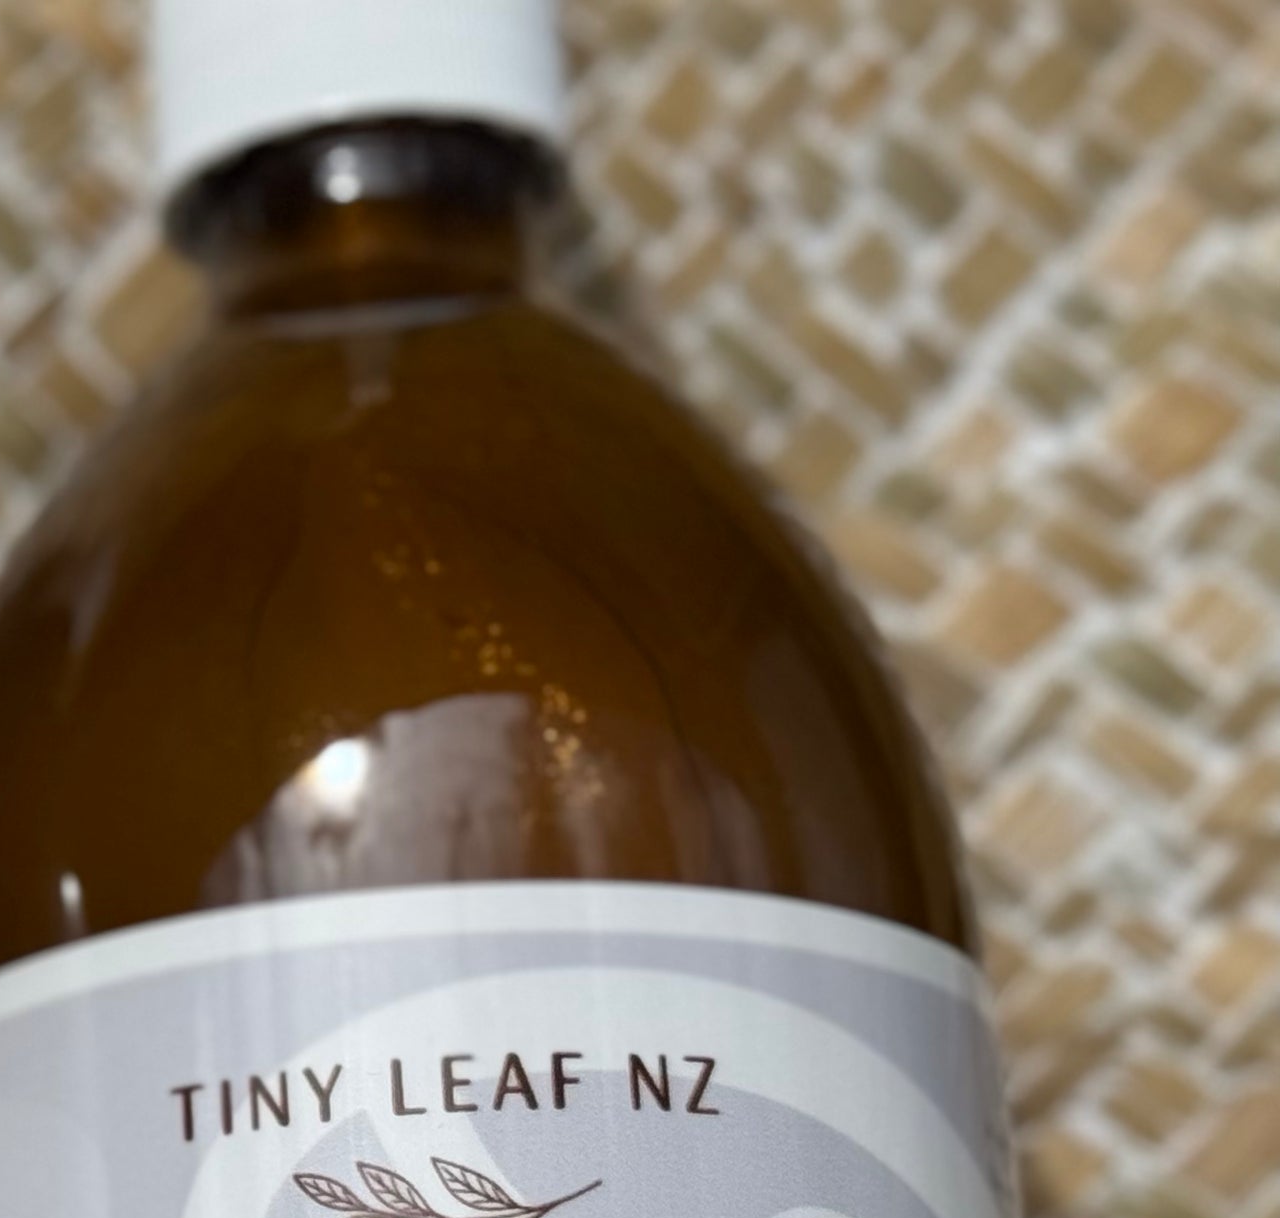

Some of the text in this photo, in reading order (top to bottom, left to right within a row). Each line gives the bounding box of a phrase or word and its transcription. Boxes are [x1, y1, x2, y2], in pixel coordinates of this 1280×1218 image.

[171, 1051, 720, 1143] TINY LEAF NZ
